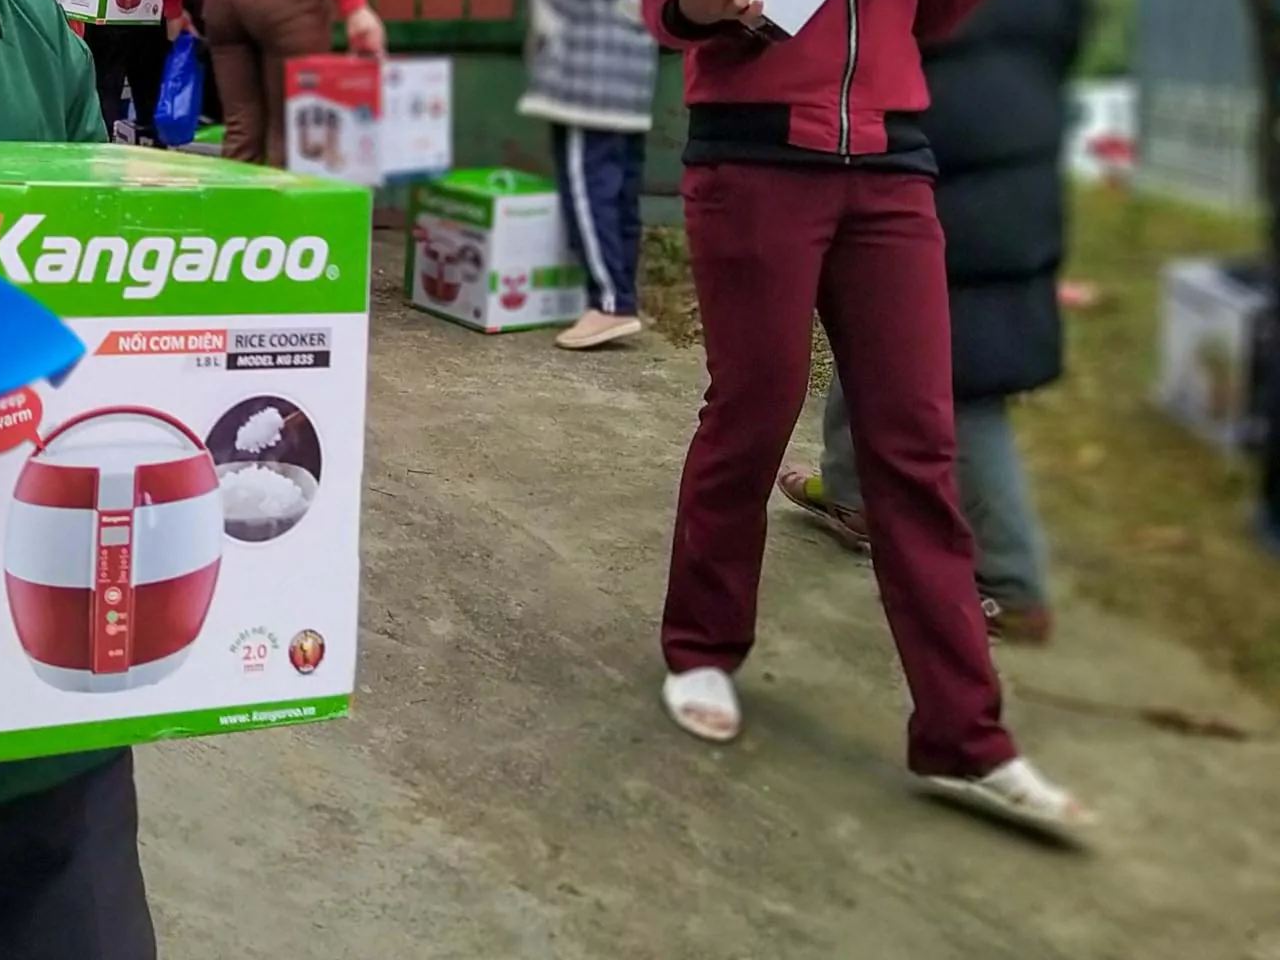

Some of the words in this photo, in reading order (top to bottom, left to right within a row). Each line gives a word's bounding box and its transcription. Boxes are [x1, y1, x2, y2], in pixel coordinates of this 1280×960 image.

[235, 333, 266, 349] RICE
[269, 332, 326, 348] COOKER
[236, 355, 274, 367] MODEL
[242, 643, 267, 661] 2.0
